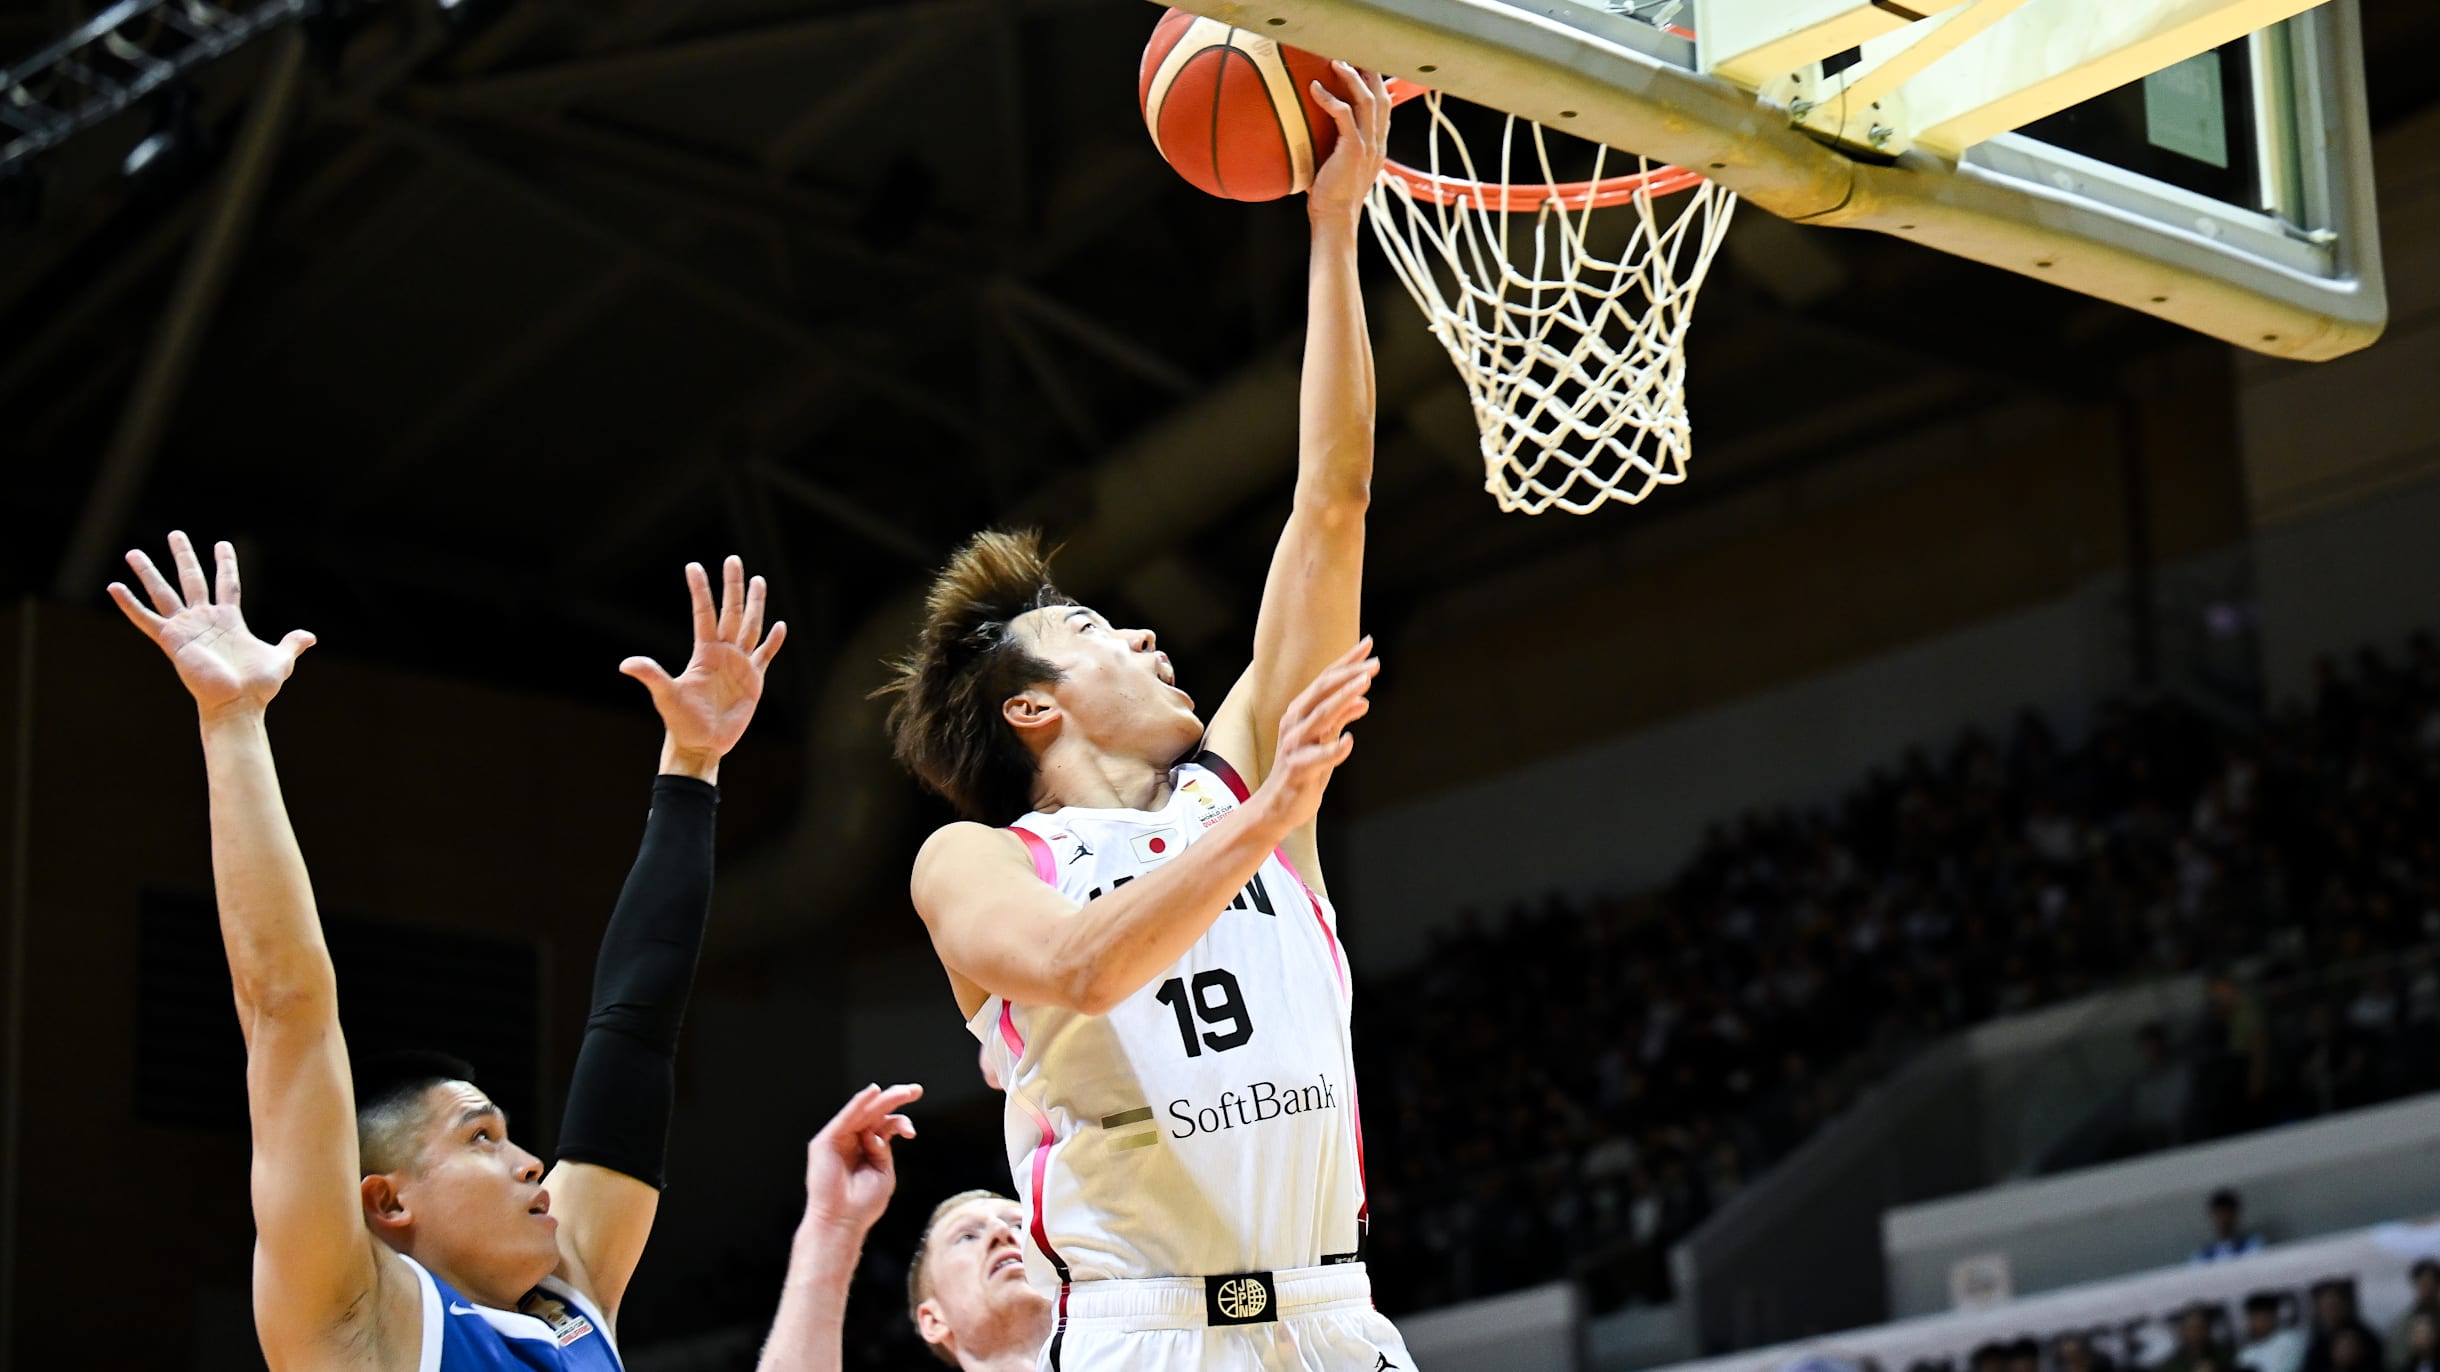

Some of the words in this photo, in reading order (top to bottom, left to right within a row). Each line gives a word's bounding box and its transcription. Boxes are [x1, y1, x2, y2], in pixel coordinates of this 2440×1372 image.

[1155, 968, 1254, 1059] 19
[1168, 1074, 1337, 1139] SoftBank
[1237, 1279, 1249, 1318] JPN
